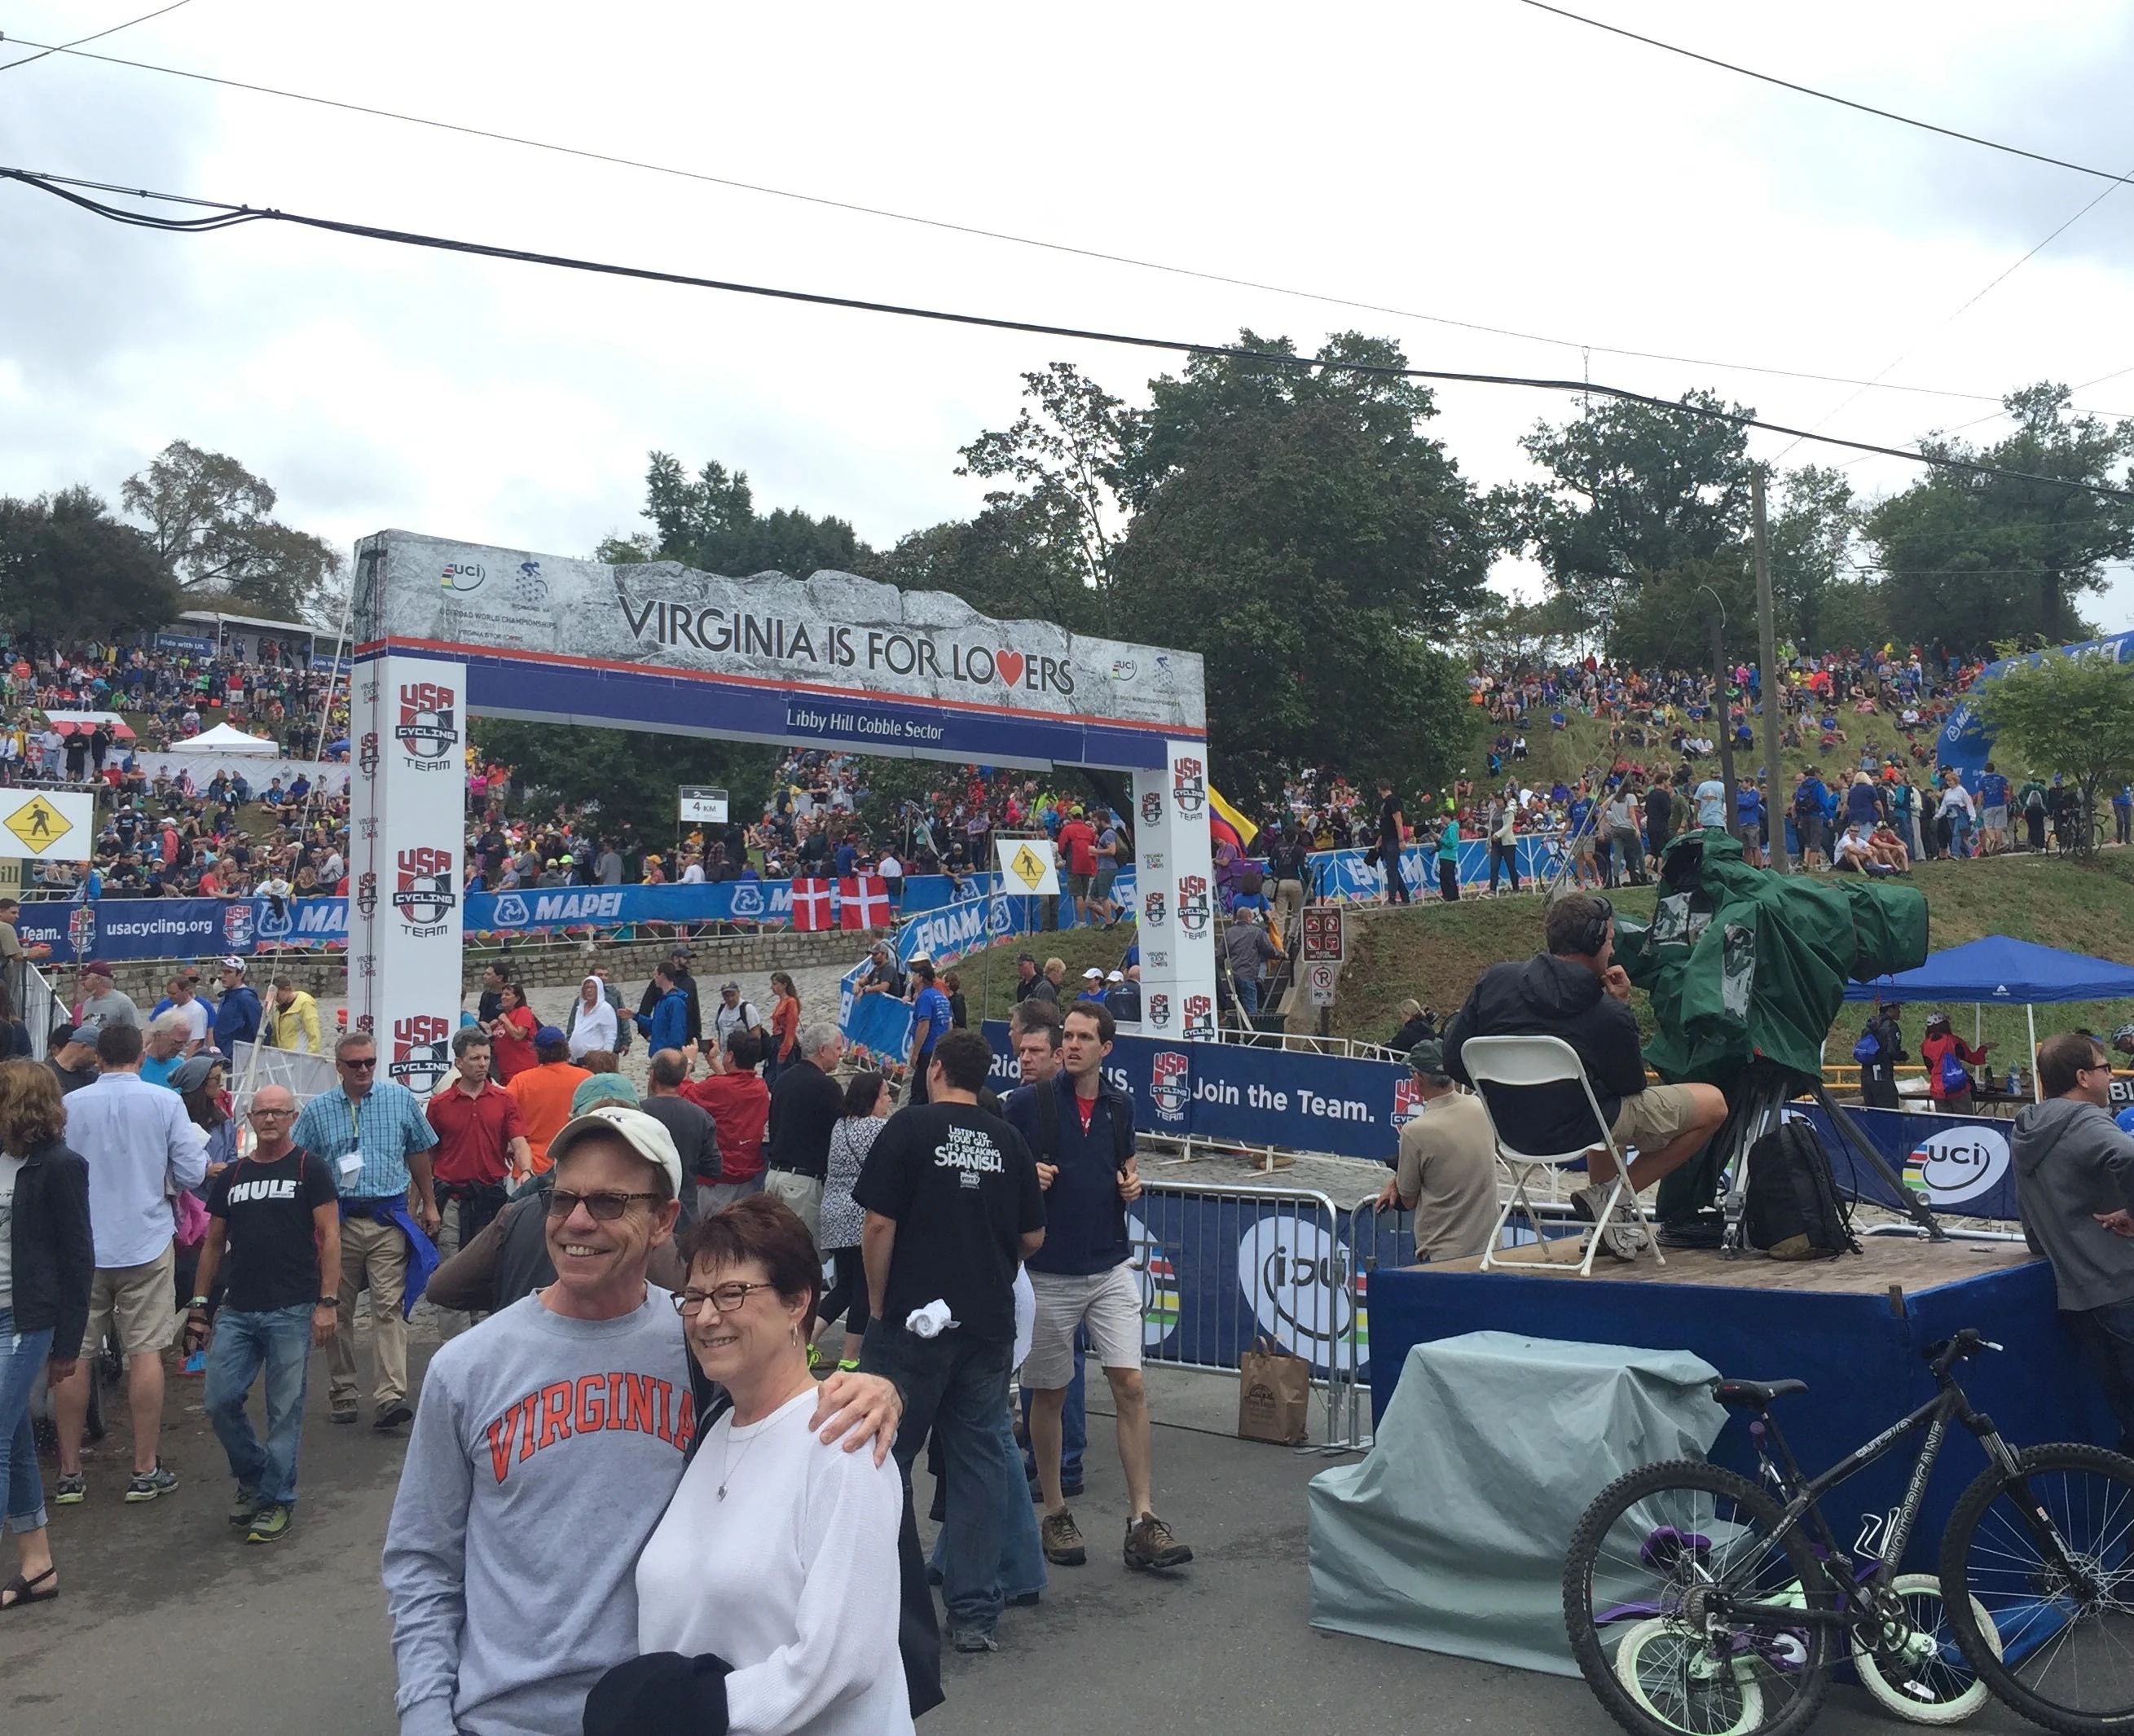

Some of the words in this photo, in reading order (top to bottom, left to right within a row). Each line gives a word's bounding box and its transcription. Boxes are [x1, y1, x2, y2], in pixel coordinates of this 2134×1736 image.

[454, 609, 473, 619] ROAD
[475, 613, 500, 622] WORLD
[501, 617, 558, 630] CHAMPIONSHIPS
[618, 595, 817, 663] VIRGINIA
[828, 626, 856, 667] IS
[869, 632, 944, 679] FOR
[401, 683, 454, 711] USA
[787, 708, 826, 732] Libby
[829, 710, 854, 731] Hill
[857, 714, 901, 736] Cobble
[904, 720, 944, 741] Sector
[398, 728, 455, 740] CYCLING
[403, 757, 450, 771] TEAM
[1174, 758, 1201, 777] USA
[693, 802, 701, 811] 4
[1142, 793, 1160, 804] USA
[1178, 811, 1202, 821] TEAM
[398, 847, 451, 876] USA
[1, 865, 19, 883] ill
[1179, 875, 1206, 896] USA
[396, 894, 452, 904] CYCLING
[1146, 892, 1164, 903] USA
[535, 893, 623, 921] MAPEI
[20, 926, 61, 941] Team.
[107, 919, 213, 938] usacycling.org
[401, 925, 447, 938] TEAM
[1183, 930, 1207, 940] TEAM
[1151, 994, 1168, 1006] USA
[1184, 995, 1211, 1017] USA
[394, 1015, 448, 1044] USA
[1185, 1029, 1213, 1037] CYCLING
[392, 1063, 449, 1074] CYCLING
[988, 1054, 1021, 1079] Rid
[1155, 1052, 1187, 1075] USA
[1152, 1087, 1187, 1096] CYCLING
[1193, 1077, 1239, 1105] Join
[1247, 1084, 1287, 1111] the
[1297, 1089, 1375, 1123] Team.
[1155, 1109, 1184, 1121] TEAM
[948, 1133, 970, 1145] YOUR
[949, 1123, 975, 1137] LISTEN
[977, 1131, 988, 1140] TO
[934, 1146, 1005, 1172] SPANISH.
[961, 1145, 1000, 1157] SPEAKING
[487, 1373, 695, 1484] VIRGINIA
[1885, 1421, 1943, 1567] MOTOBECANE
